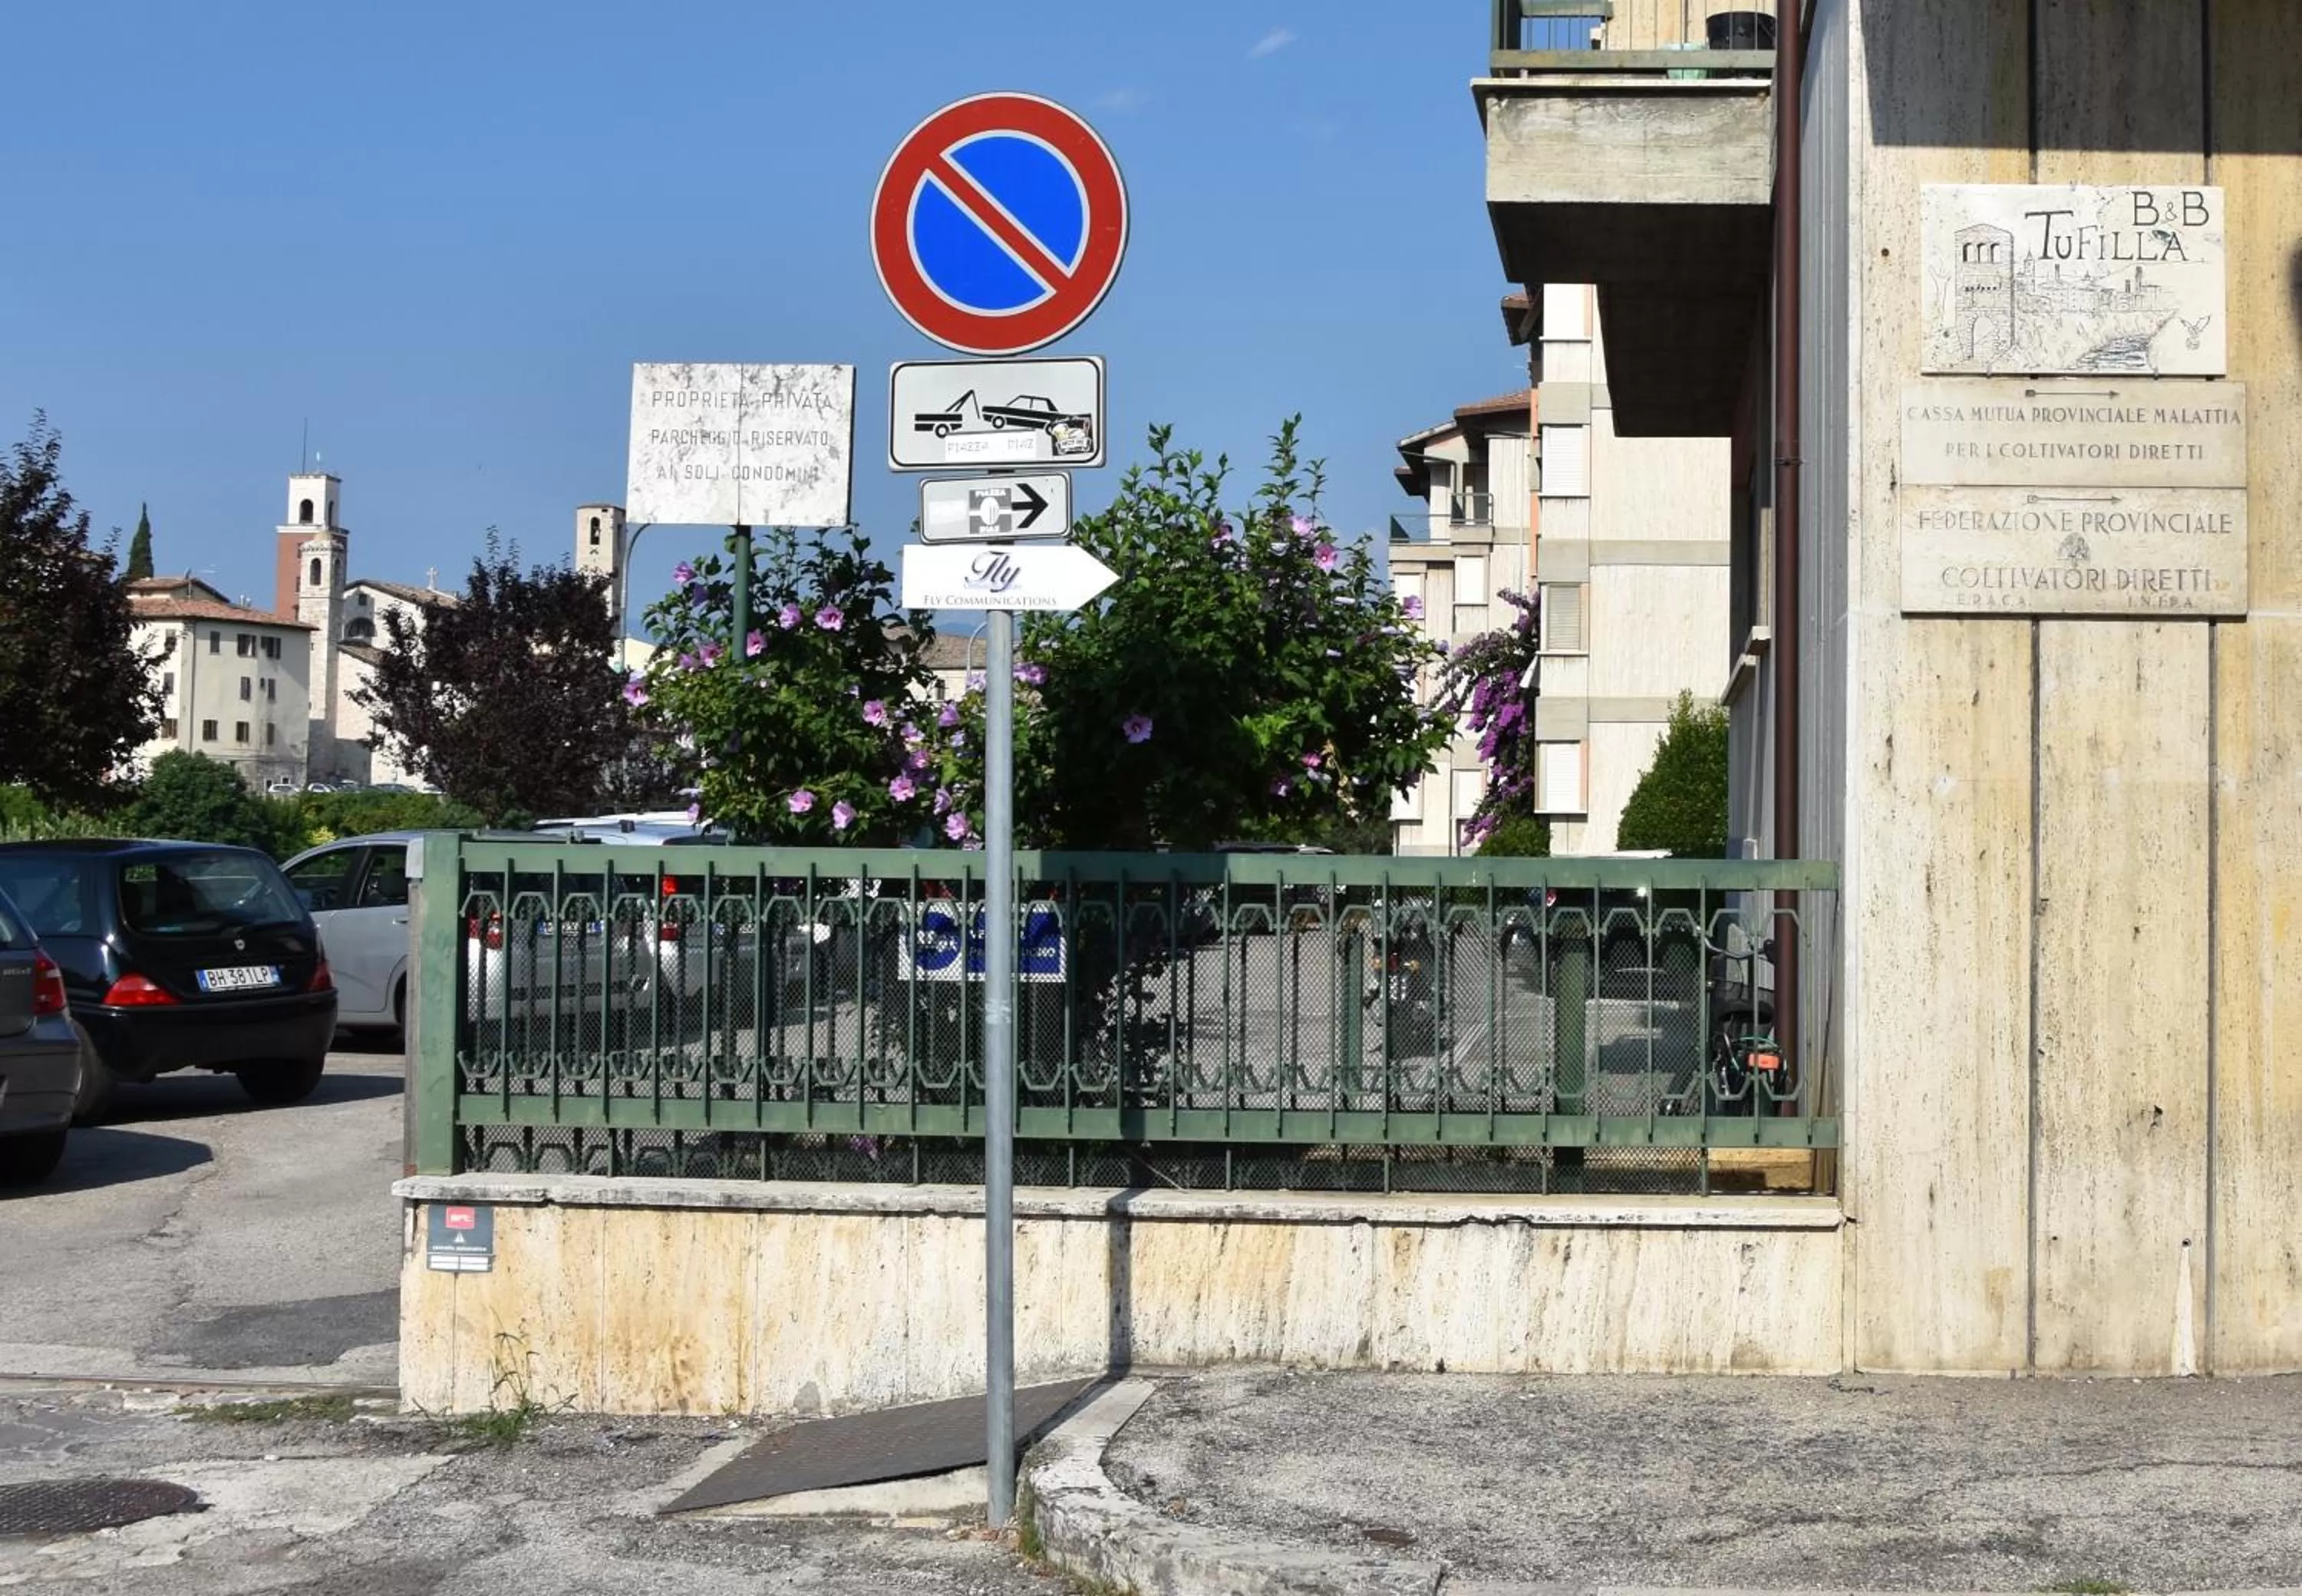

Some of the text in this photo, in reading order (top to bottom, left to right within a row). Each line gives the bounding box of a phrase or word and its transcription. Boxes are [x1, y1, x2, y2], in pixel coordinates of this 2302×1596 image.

[762, 392, 833, 410] PRIVATA
[1907, 407, 2241, 425] CASSA MUTUA PROVINCIALE MALATTIA
[651, 429, 829, 447] PARCHEGGIO RISERVATO
[1945, 442, 1979, 457] PER
[1999, 443, 2119, 459] COLTIVATORI
[2129, 444, 2205, 460] DIRETTI
[684, 464, 719, 480] SOLI
[1918, 511, 2233, 535] FEDERAZIONE PROVINCIALE
[1941, 566, 2211, 592] COLTIVATORI DIRETTI
[207, 970, 226, 986] BH
